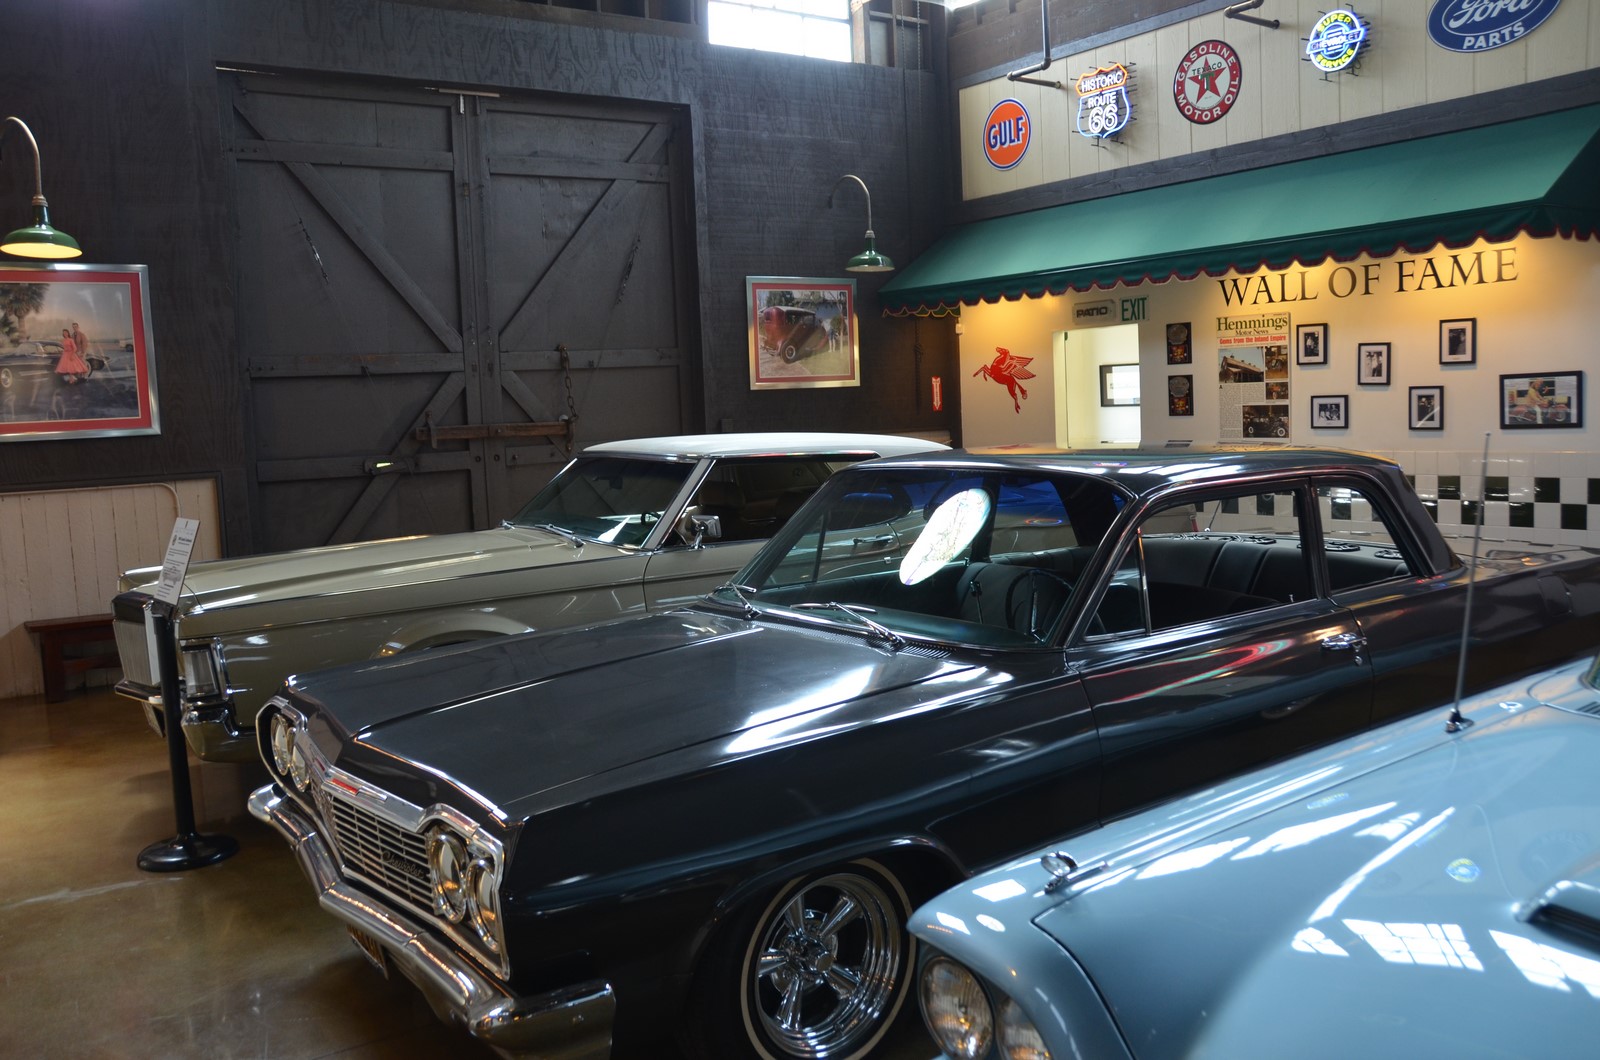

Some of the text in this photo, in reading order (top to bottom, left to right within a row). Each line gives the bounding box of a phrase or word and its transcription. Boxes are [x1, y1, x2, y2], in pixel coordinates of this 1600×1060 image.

[1317, 13, 1352, 32] SUPER
[1311, 31, 1360, 50] CHEVROLET
[1462, 22, 1525, 49] PARTS
[1177, 44, 1236, 81] GASOLINE
[1192, 62, 1222, 75] TEXACO
[1316, 48, 1354, 68] SERVICE
[1081, 71, 1123, 93] HISTORIC
[1087, 91, 1117, 108] ROUTE
[1178, 77, 1239, 121] MOTOR OIL
[1088, 104, 1118, 134] 66
[988, 116, 1025, 151] GULF
[1217, 247, 1518, 307] WALL OF FAME
[1076, 306, 1108, 318] PATIO
[1121, 297, 1147, 321] EXIT
[1216, 314, 1288, 331] Hemmings
[382, 850, 424, 878] Chevrolet
